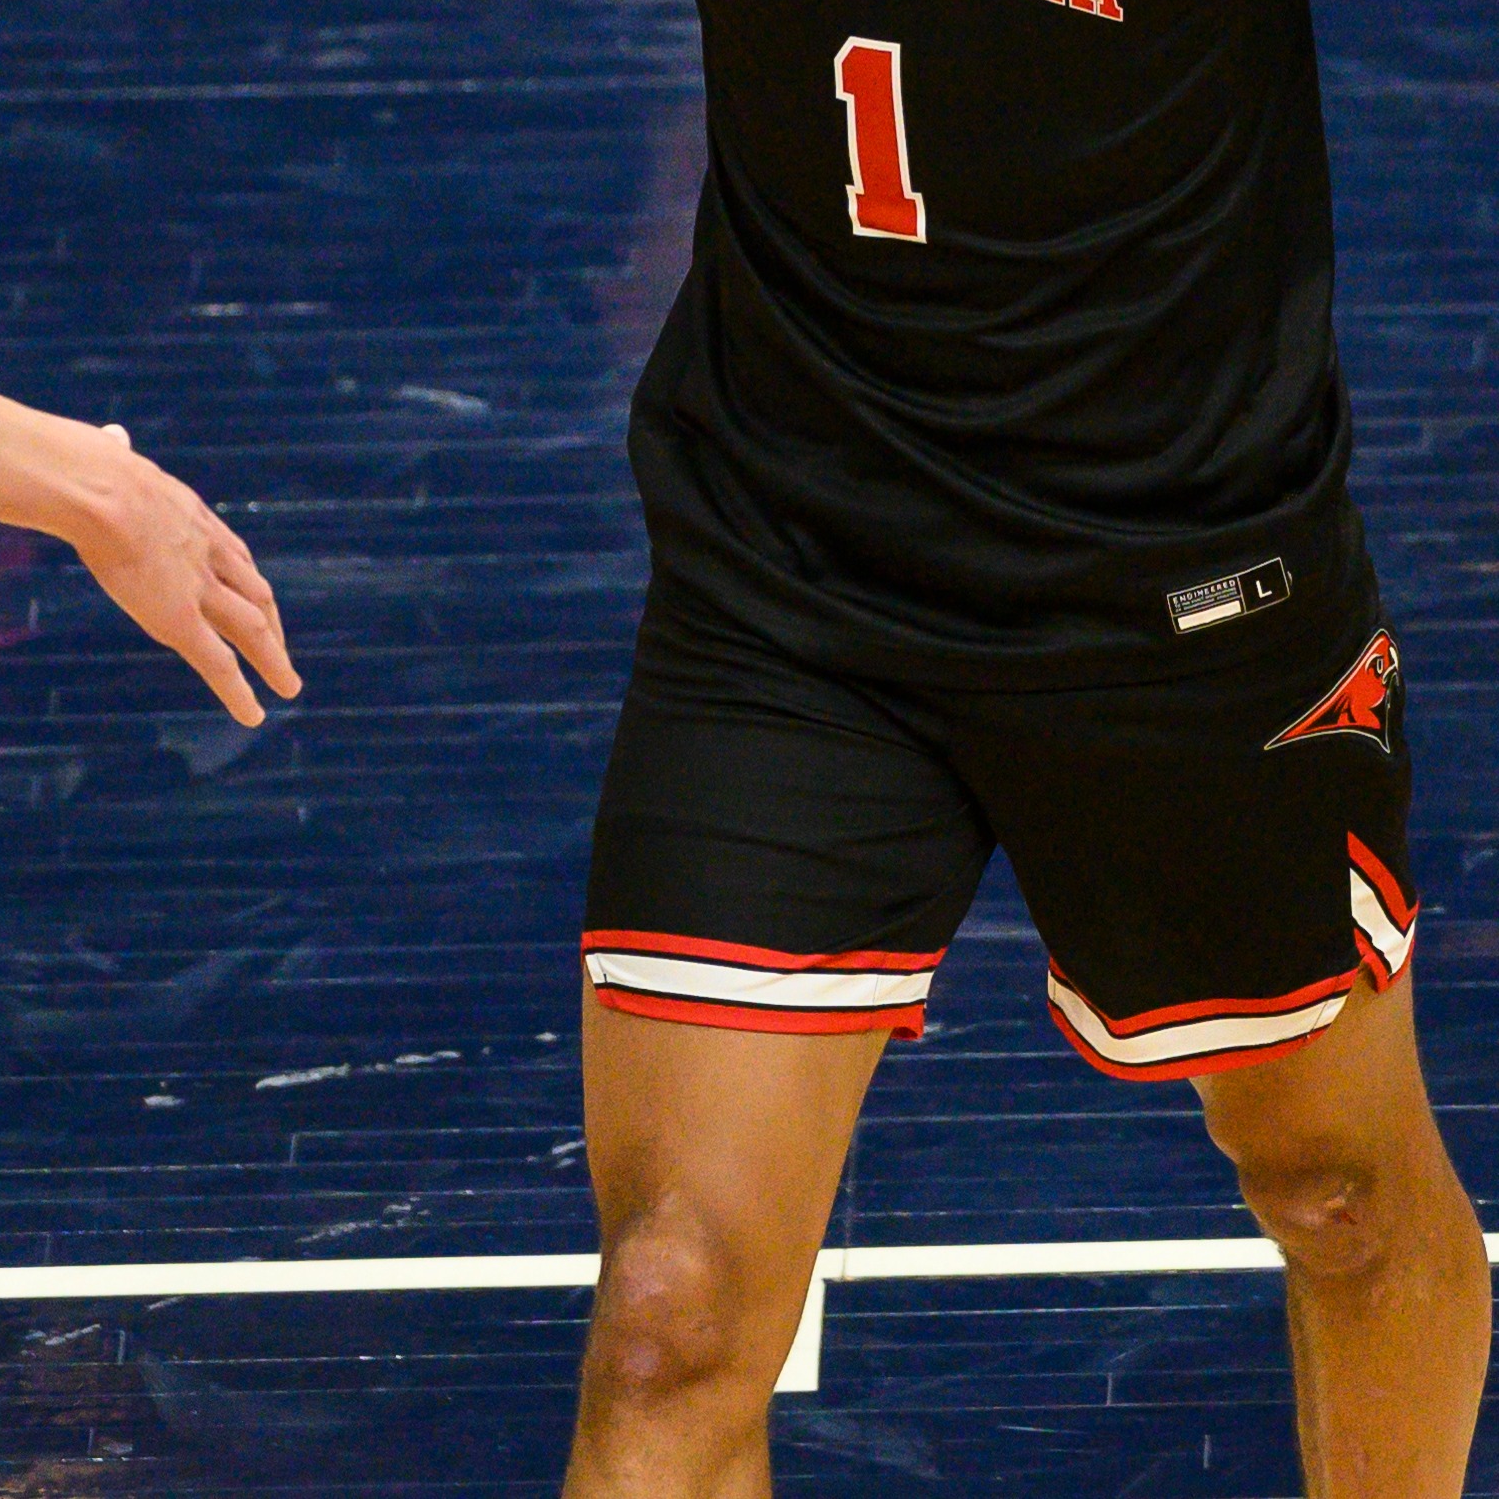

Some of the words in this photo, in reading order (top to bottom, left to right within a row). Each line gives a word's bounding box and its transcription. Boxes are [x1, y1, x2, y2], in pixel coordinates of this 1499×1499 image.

[833, 35, 927, 244] 1
[1172, 579, 1236, 605] ENGINEERED
[1255, 580, 1273, 599] L
